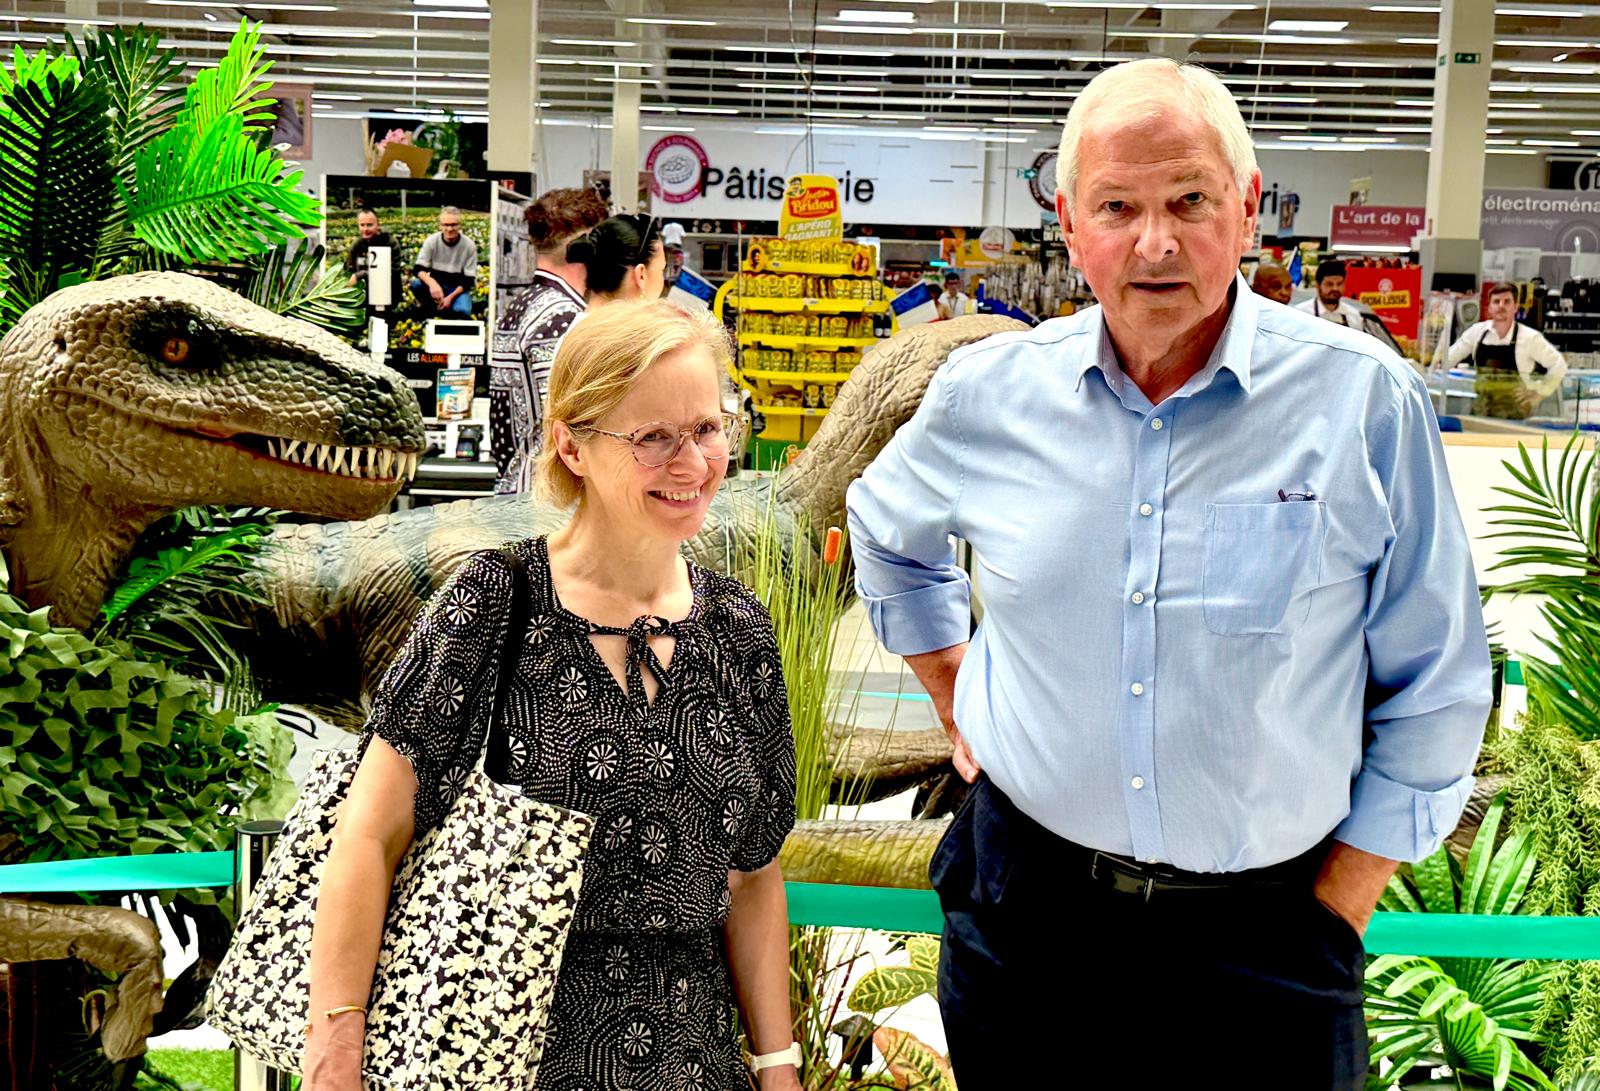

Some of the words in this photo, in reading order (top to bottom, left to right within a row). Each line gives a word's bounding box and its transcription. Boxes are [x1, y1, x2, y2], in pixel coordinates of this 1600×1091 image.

[791, 199, 834, 213] Bridou
[790, 219, 831, 231] L'APÉRO
[1339, 210, 1375, 224] L'art
[1380, 212, 1401, 225] de
[1405, 212, 1420, 226] la
[369, 250, 378, 268] 2
[407, 353, 420, 363] LES
[420, 354, 448, 364] ALLIANC
